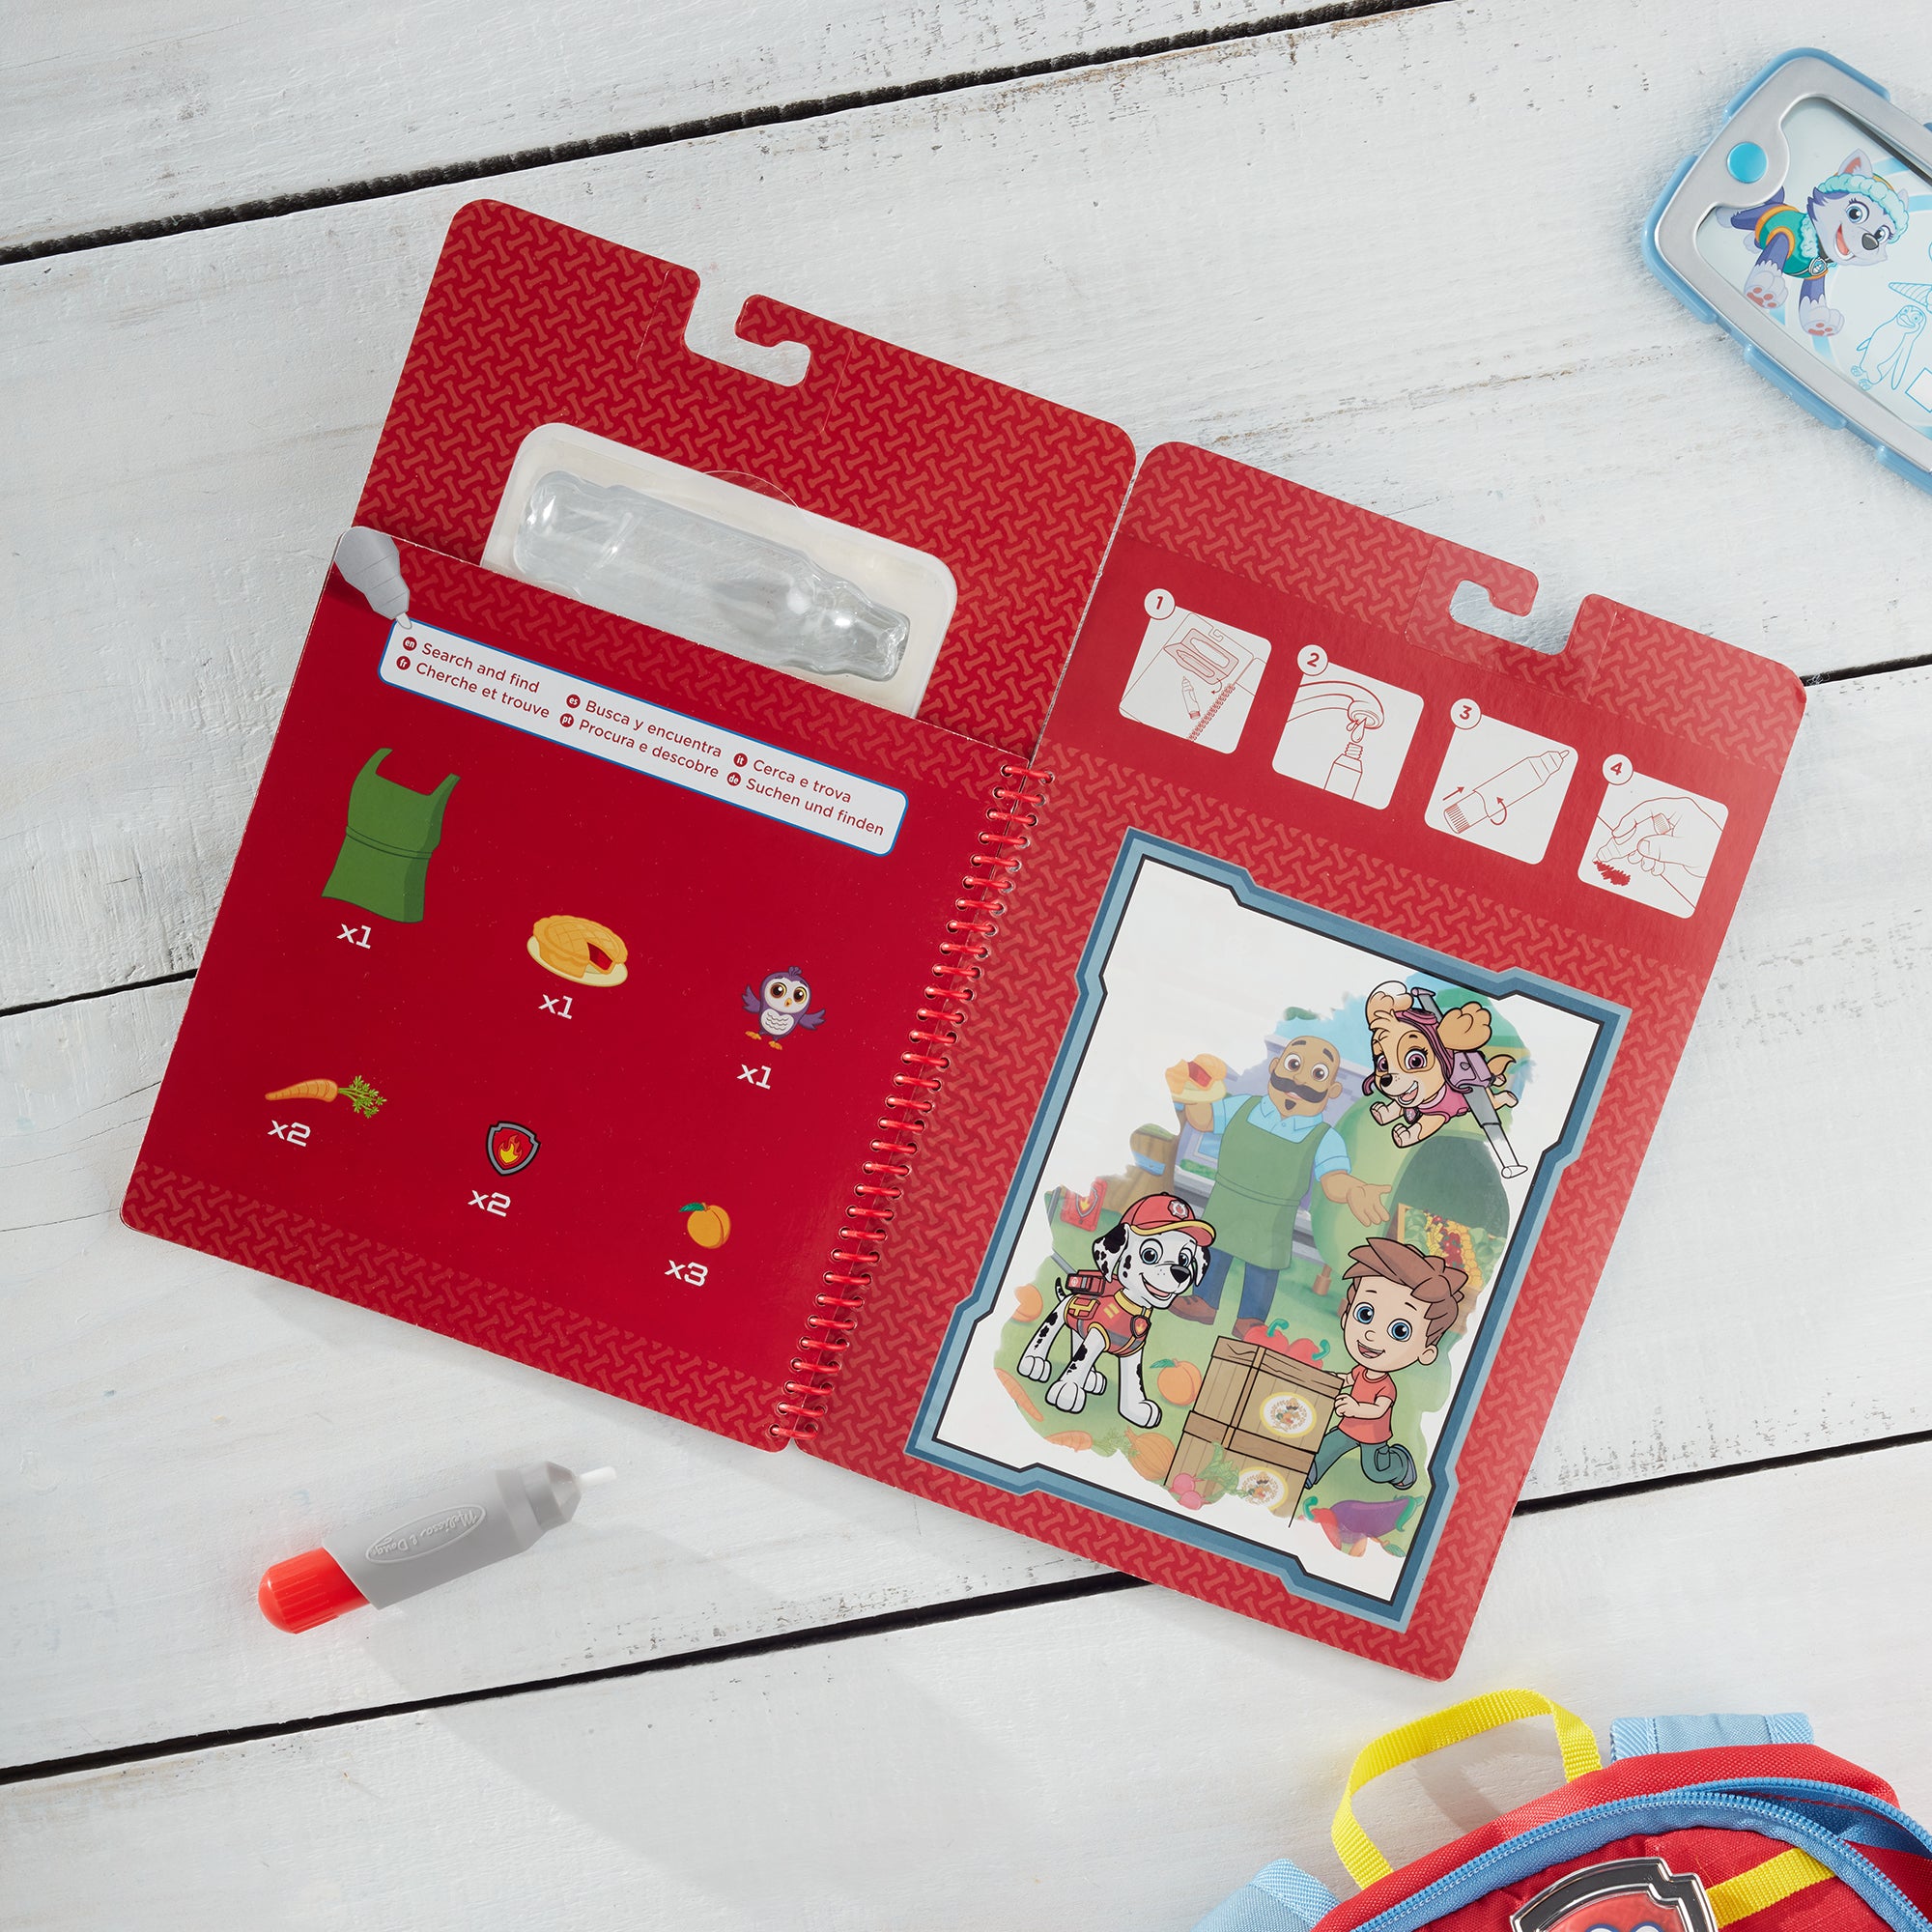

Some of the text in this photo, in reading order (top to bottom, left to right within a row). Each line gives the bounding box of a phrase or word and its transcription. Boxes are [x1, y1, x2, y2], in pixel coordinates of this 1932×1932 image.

[1156, 595, 1164, 611] 1
[404, 639, 540, 694] en Search and find
[1306, 652, 1320, 668] 2
[399, 658, 550, 719] fr Cherche et trouve
[1459, 704, 1472, 721] 3
[568, 696, 723, 758] es Busca y encuentra
[561, 716, 719, 778] pt Procura e descobre
[736, 754, 851, 804] it Cerca e trova
[1610, 762, 1623, 776] 4
[727, 774, 884, 836] de Suchen und finden
[336, 923, 372, 950] x1
[538, 994, 573, 1020] x1
[736, 1064, 772, 1090] x1
[267, 1120, 311, 1148] x2
[468, 1189, 511, 1217] x2
[664, 1259, 709, 1287] x3
[420, 1510, 477, 1537] Melissa
